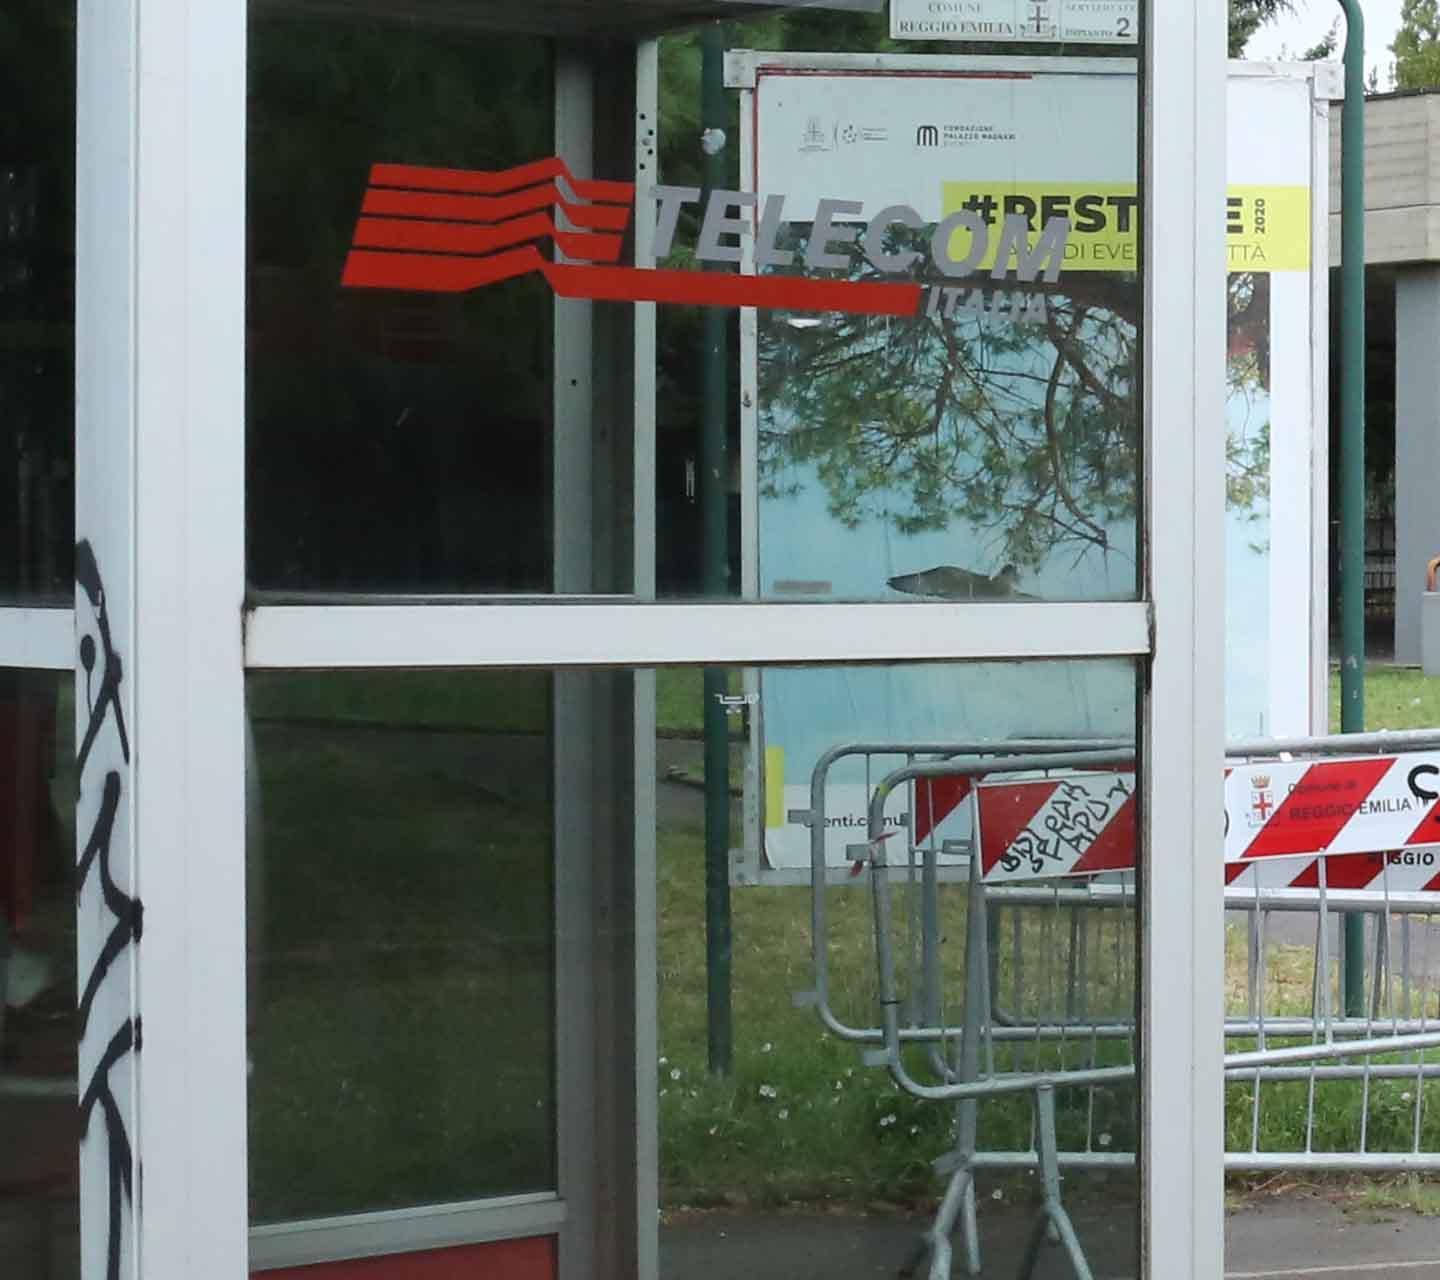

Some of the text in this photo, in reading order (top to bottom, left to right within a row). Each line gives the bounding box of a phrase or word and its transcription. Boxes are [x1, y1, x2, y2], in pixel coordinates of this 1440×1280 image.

[898, 20, 1014, 35] REGGIO EMILIA
[1115, 17, 1131, 38] 2
[1254, 197, 1267, 235] 2020
[648, 183, 1072, 284] TELECOM
[925, 284, 1048, 322] ITALIA
[1288, 797, 1412, 821] REGGIO EMILIA
